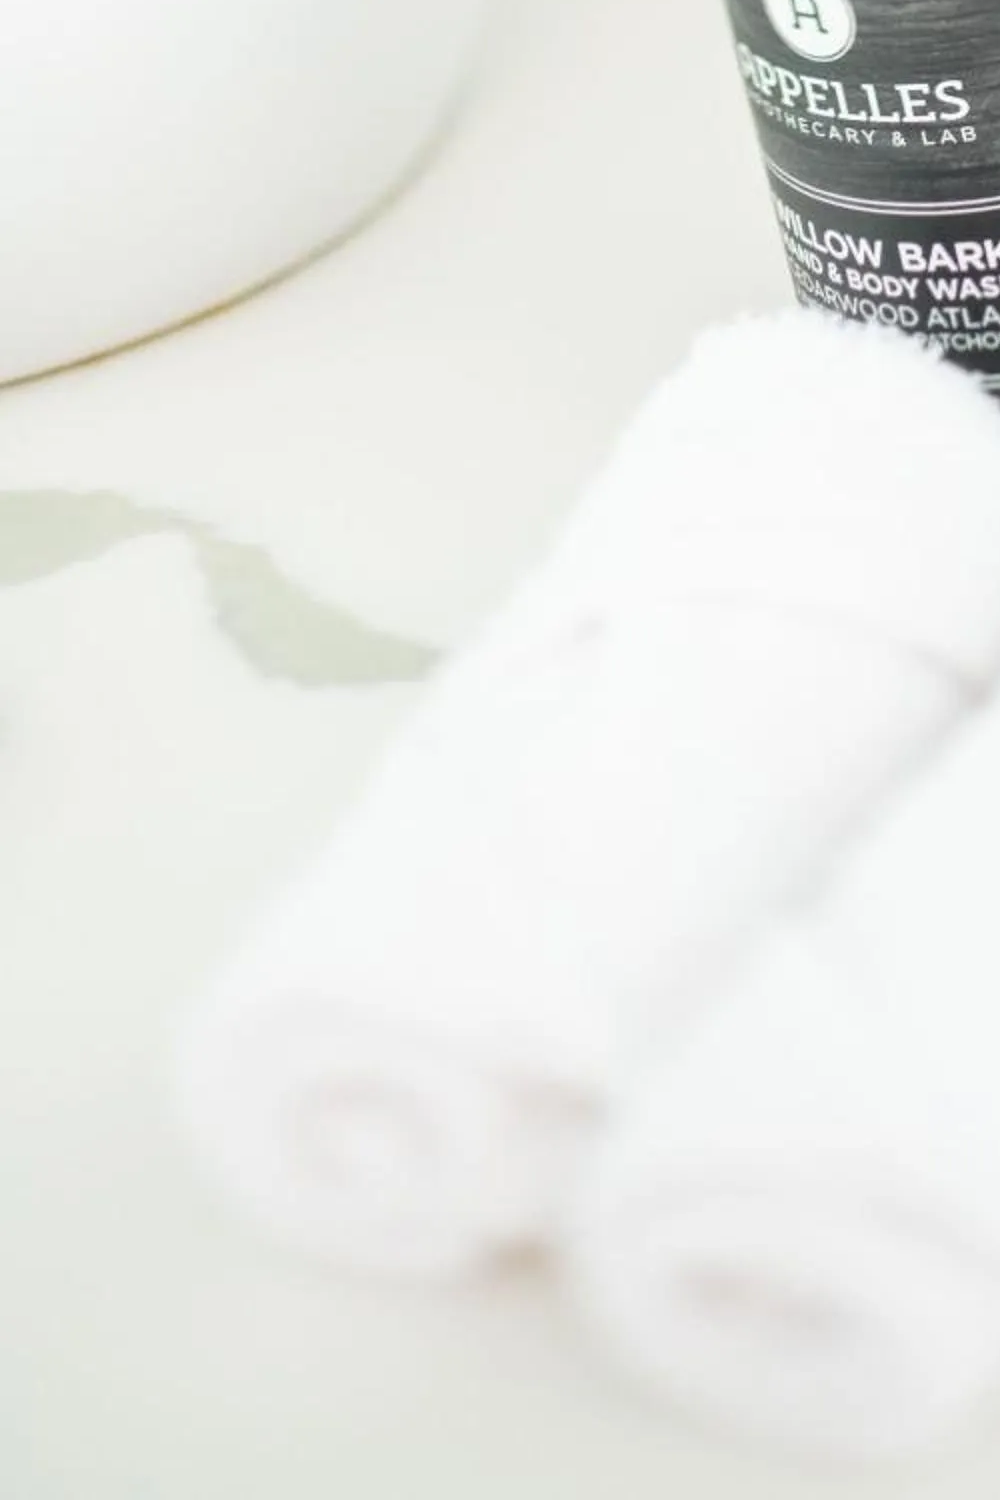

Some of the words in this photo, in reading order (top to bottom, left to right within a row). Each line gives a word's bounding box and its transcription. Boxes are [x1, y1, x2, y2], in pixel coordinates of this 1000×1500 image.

[891, 131, 907, 148] &
[921, 126, 978, 147] LAB
[826, 261, 844, 285] &
[845, 266, 919, 300] BODY
